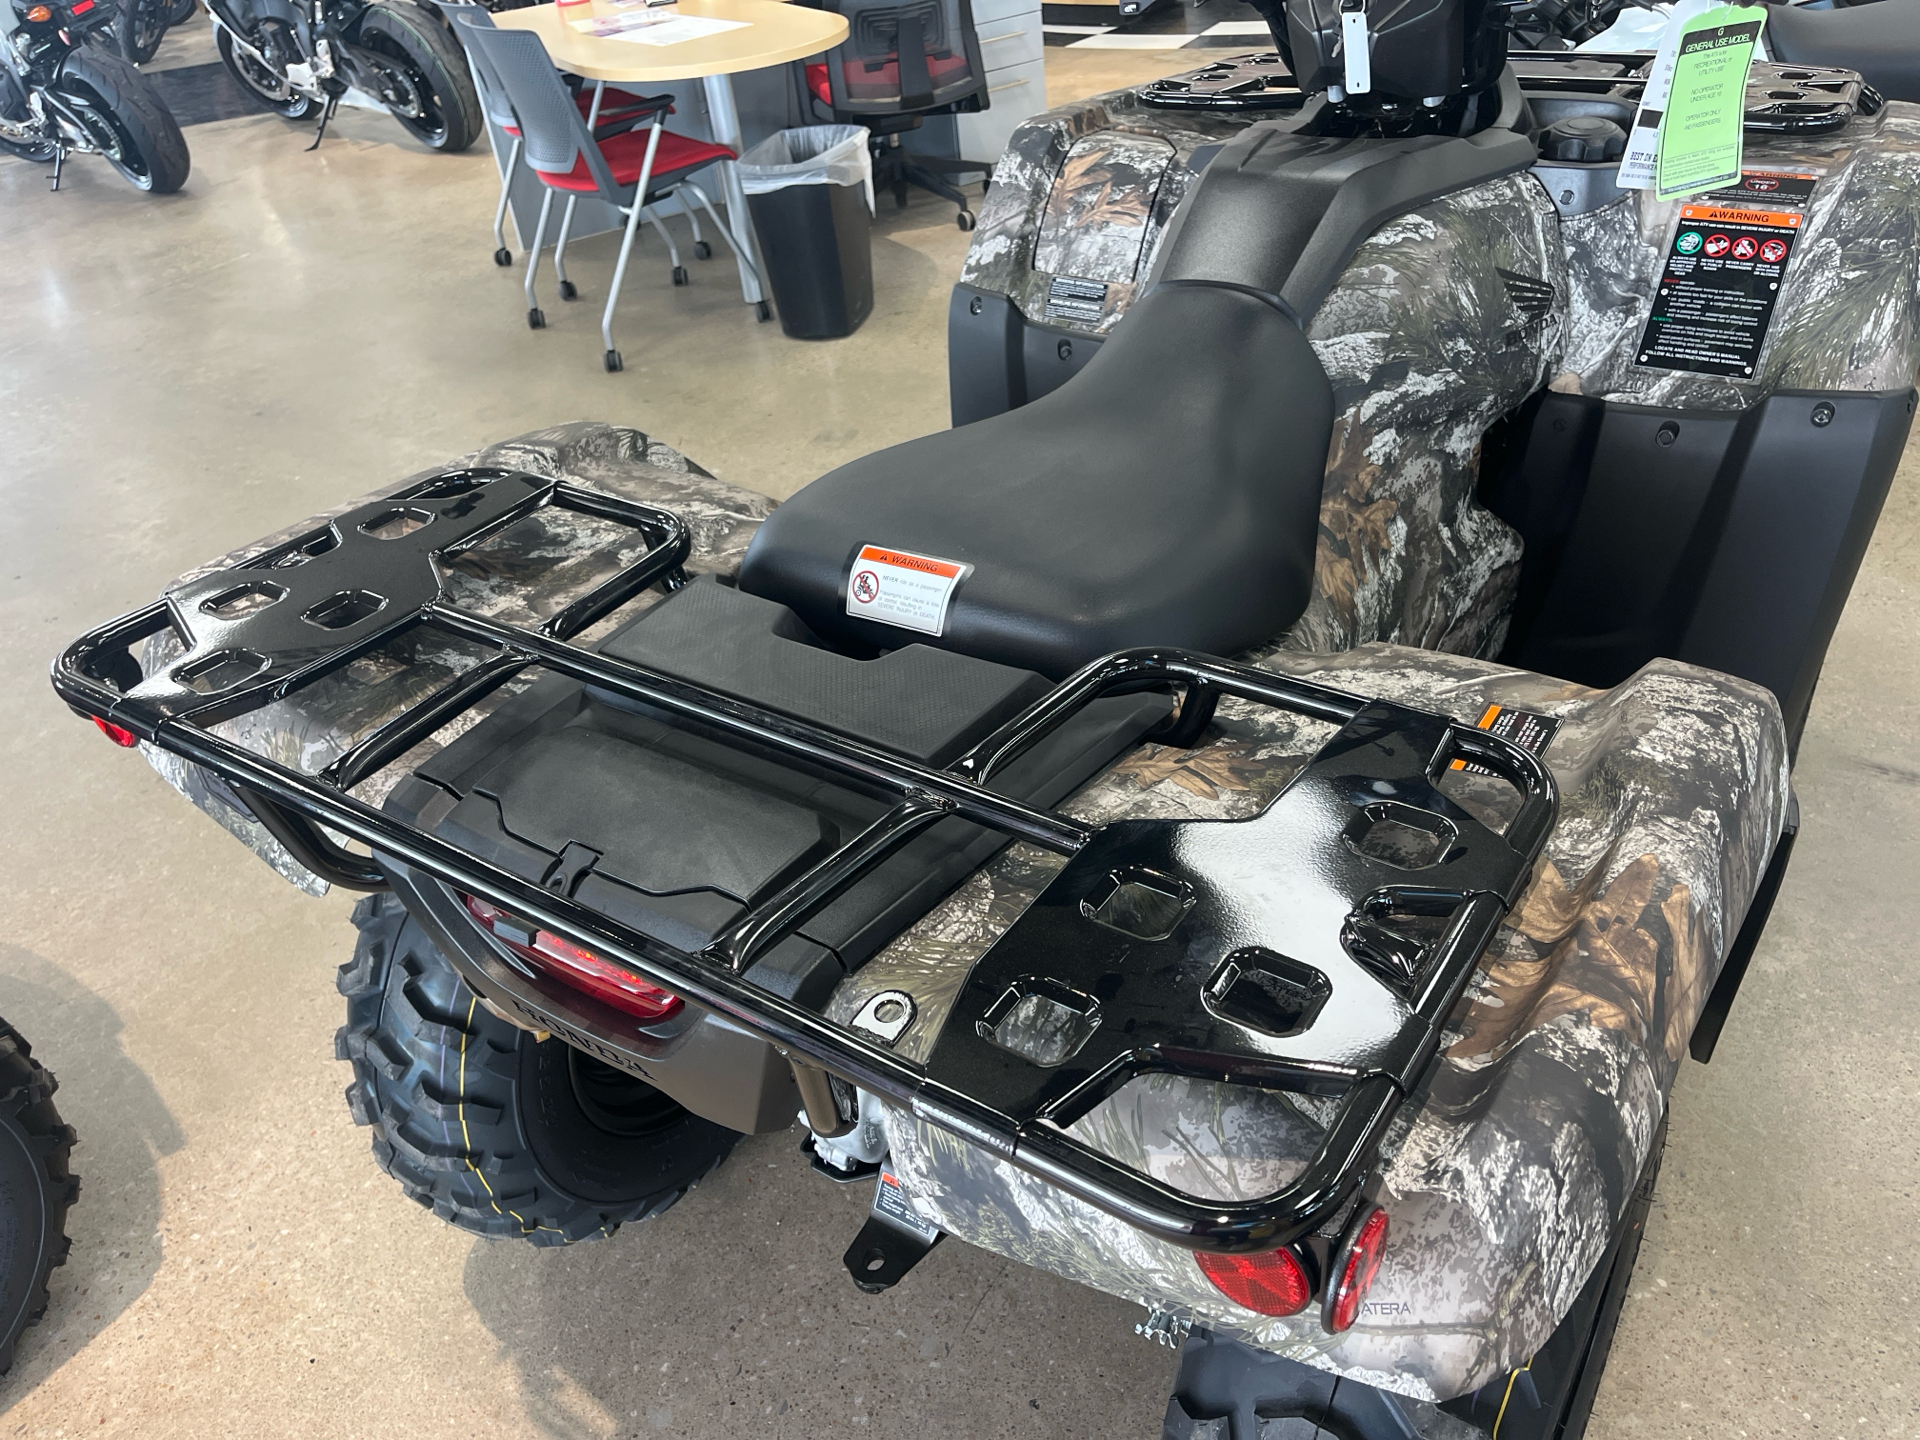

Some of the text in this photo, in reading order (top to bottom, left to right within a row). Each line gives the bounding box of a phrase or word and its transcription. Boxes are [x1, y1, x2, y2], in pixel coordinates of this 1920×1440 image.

[1686, 34, 1750, 52] GENERAL USE MODEL
[1718, 211, 1769, 222] WARNING
[892, 555, 938, 572] WARNING
[1361, 1303, 1411, 1315] ATERA
